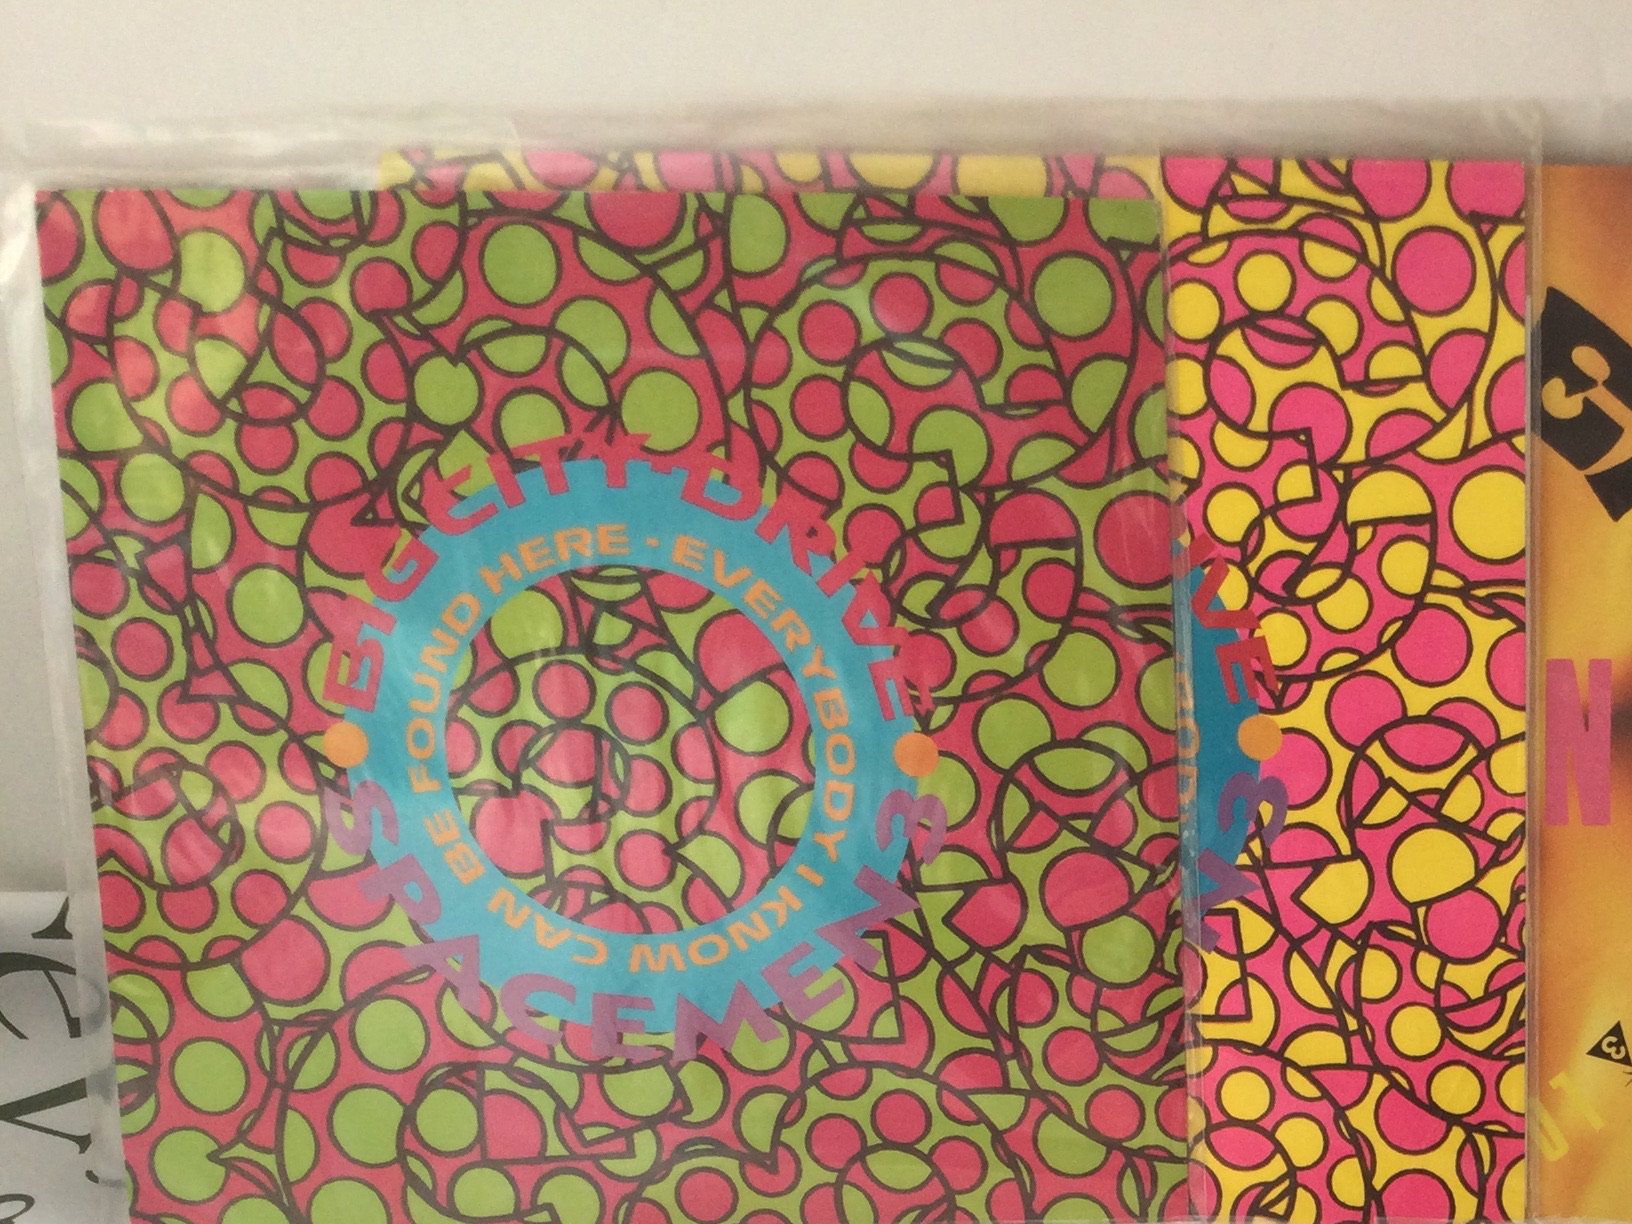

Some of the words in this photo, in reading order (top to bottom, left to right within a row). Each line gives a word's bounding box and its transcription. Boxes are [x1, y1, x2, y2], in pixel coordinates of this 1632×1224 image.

[323, 524, 439, 712] BIG
[420, 431, 651, 535] CITY
[480, 523, 630, 595] HERE
[405, 591, 481, 795] FOUND
[671, 533, 856, 863] EVERYBODY
[422, 808, 486, 885] BE
[796, 864, 825, 887] I
[323, 779, 921, 1067] SPACEMEN
[487, 888, 609, 966] CAN
[628, 886, 803, 974] KNOW
